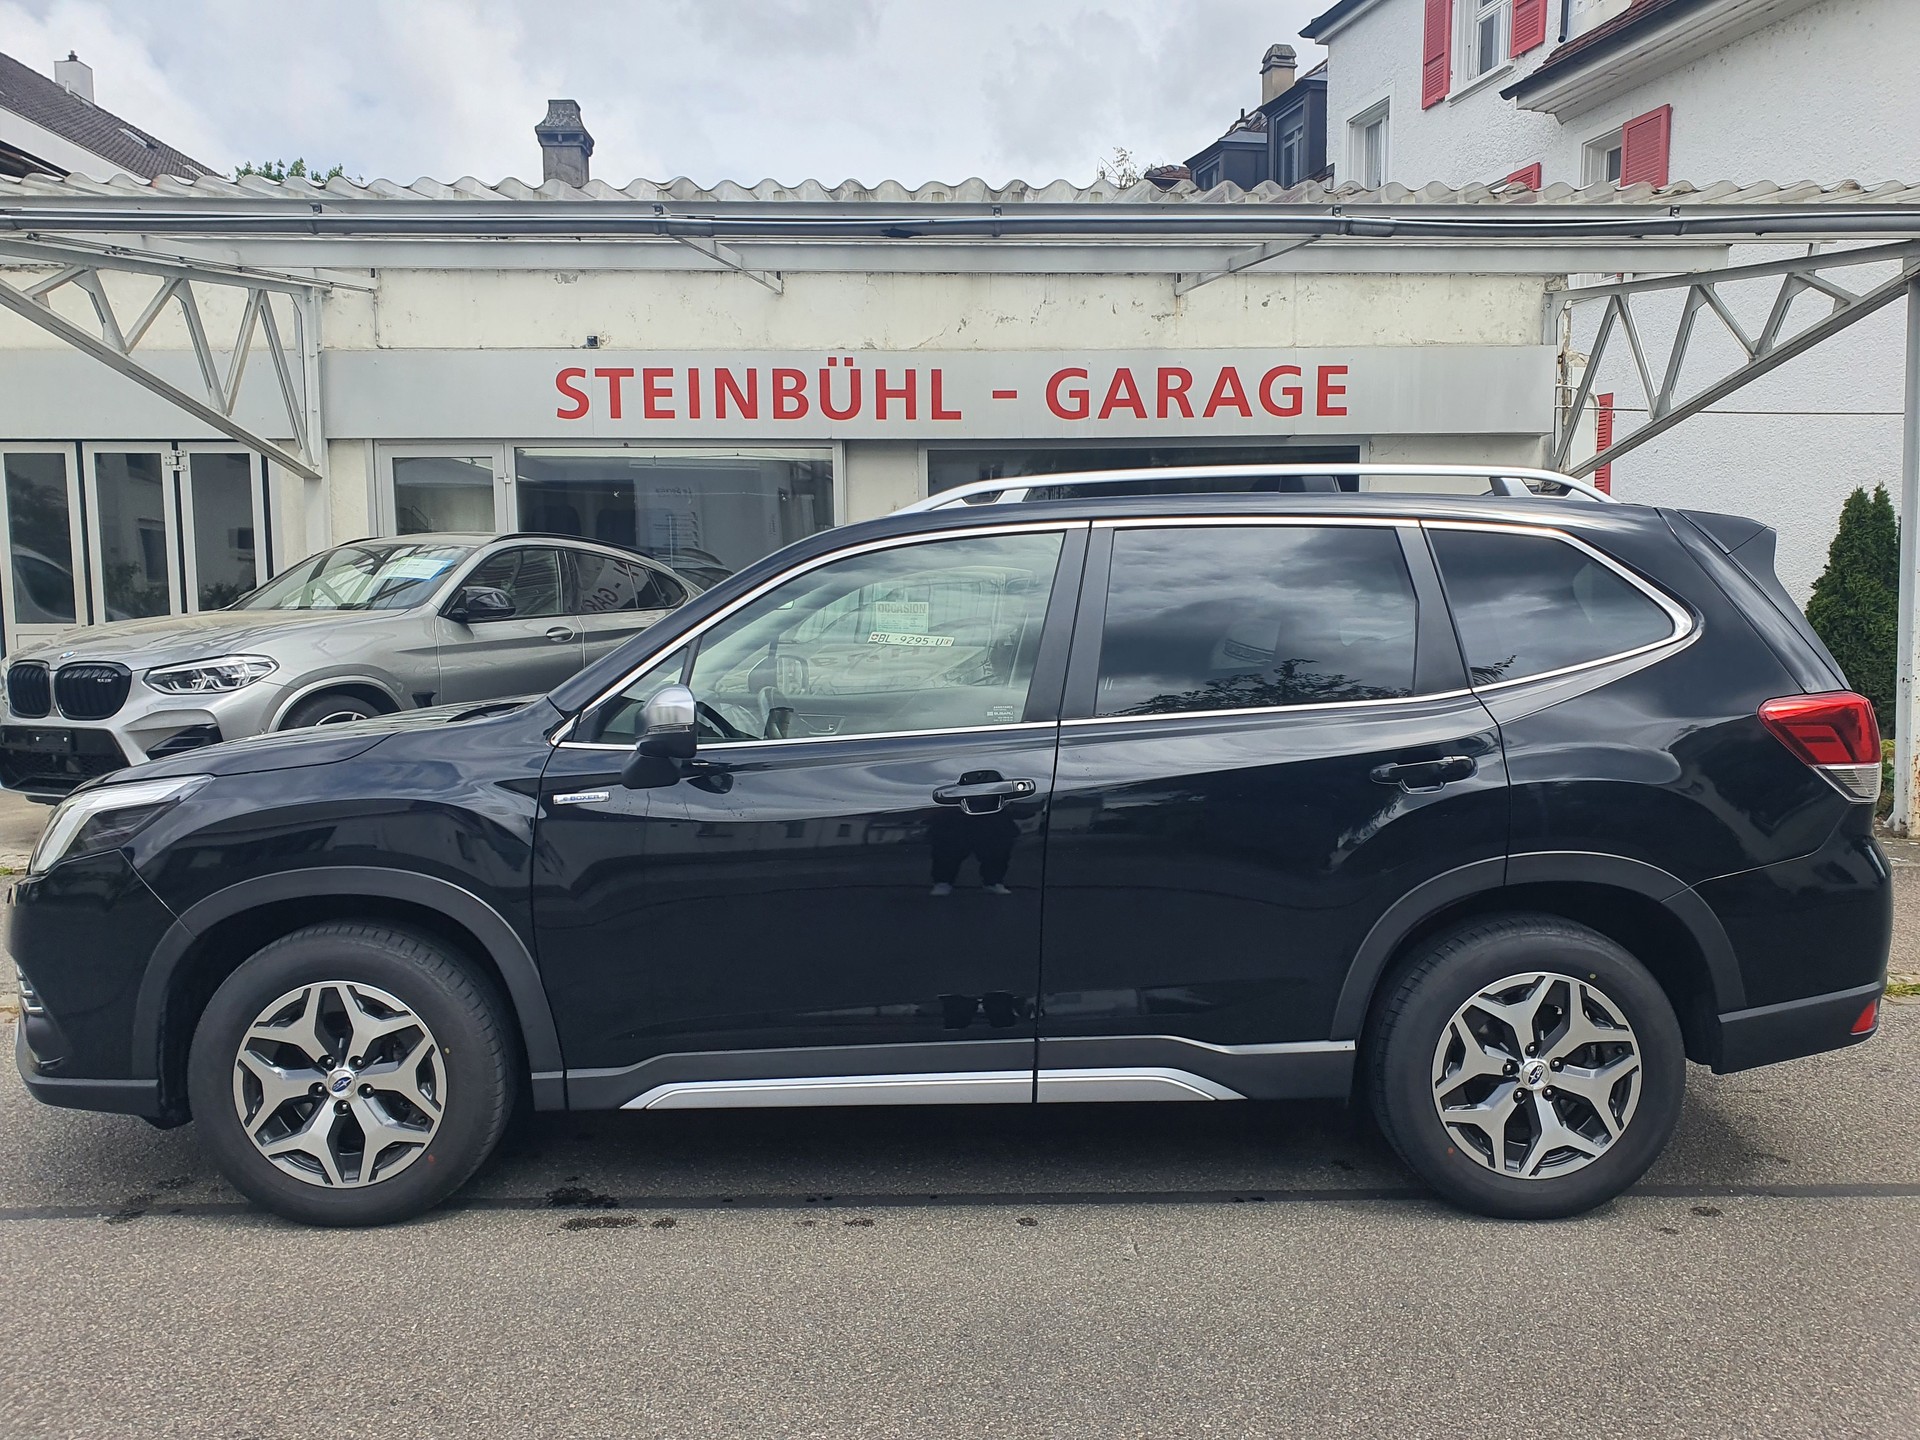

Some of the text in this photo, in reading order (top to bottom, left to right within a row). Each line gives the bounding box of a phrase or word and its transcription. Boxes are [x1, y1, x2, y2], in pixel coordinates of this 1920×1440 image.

[555, 356, 962, 420] STEINBÜHL
[1045, 364, 1349, 421] GARAGE
[877, 603, 927, 614] OCCASION
